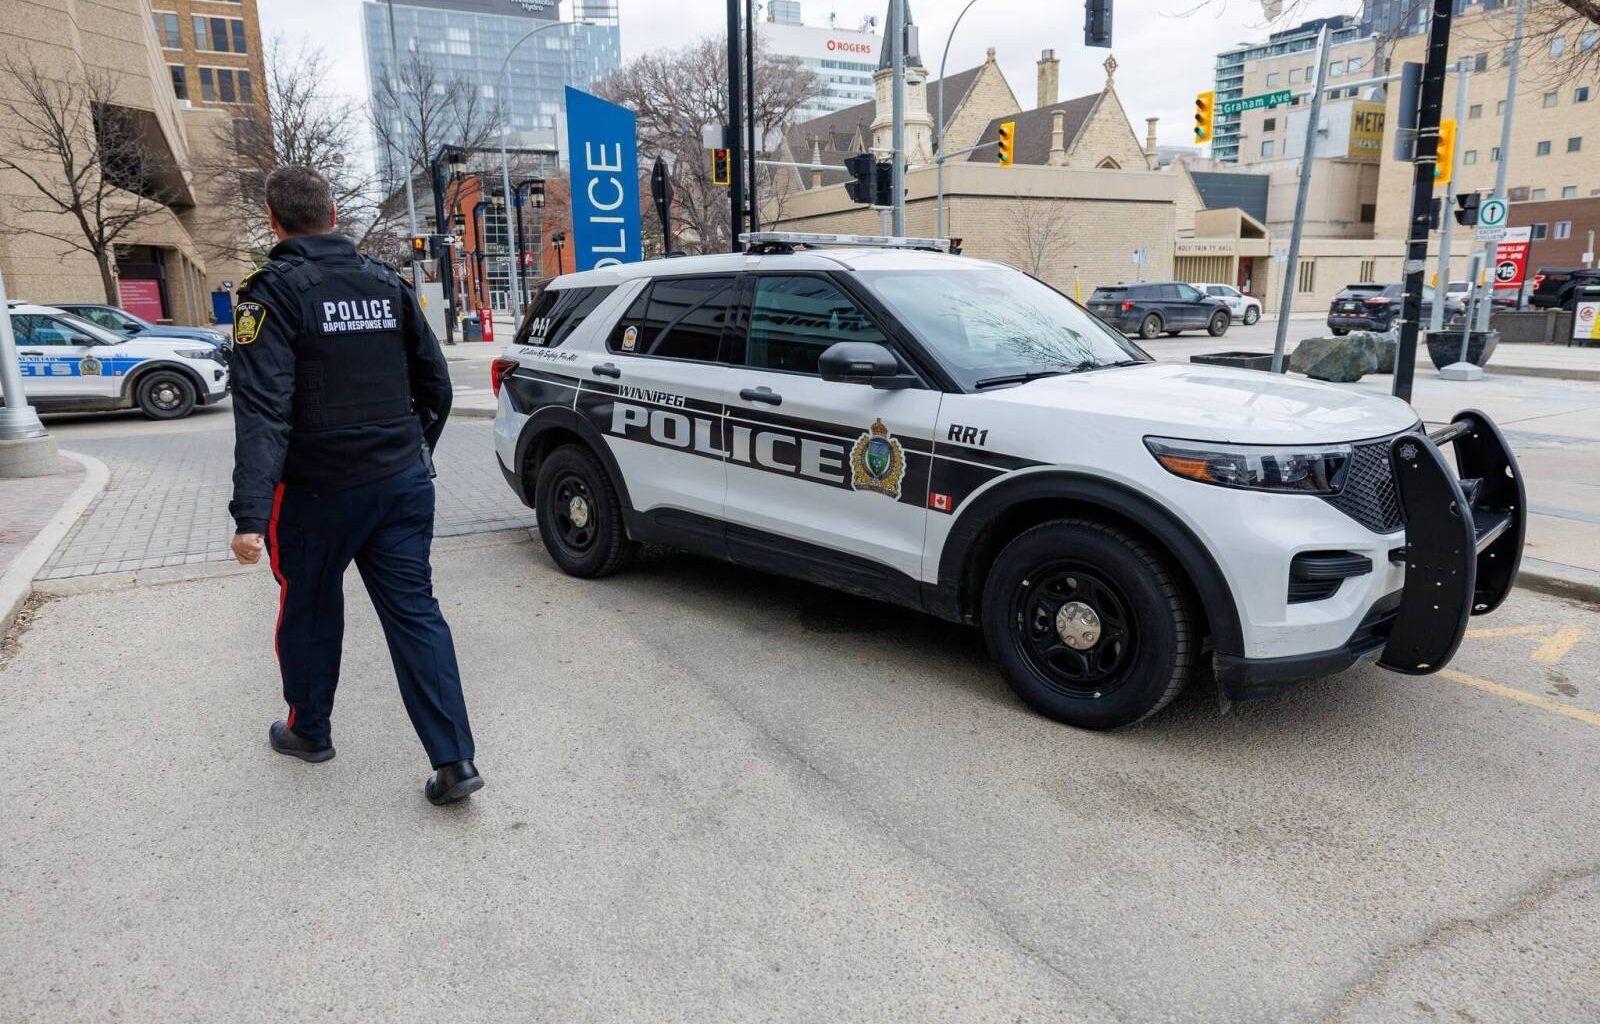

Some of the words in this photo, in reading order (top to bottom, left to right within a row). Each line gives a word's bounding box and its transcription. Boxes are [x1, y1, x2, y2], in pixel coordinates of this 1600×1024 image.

[522, 2, 544, 12] Hydro
[837, 42, 871, 54] ROGERS
[1224, 97, 1265, 113] Graham
[1269, 91, 1290, 104] Ave
[238, 304, 260, 312] POLICE
[323, 299, 393, 321] POLICE
[323, 321, 347, 332] RAPID
[348, 319, 382, 331] RESPONSE
[382, 318, 397, 329] UNIT
[619, 385, 685, 407] WINNIPEG
[611, 401, 844, 483] POLICE
[947, 424, 989, 446] RR1
